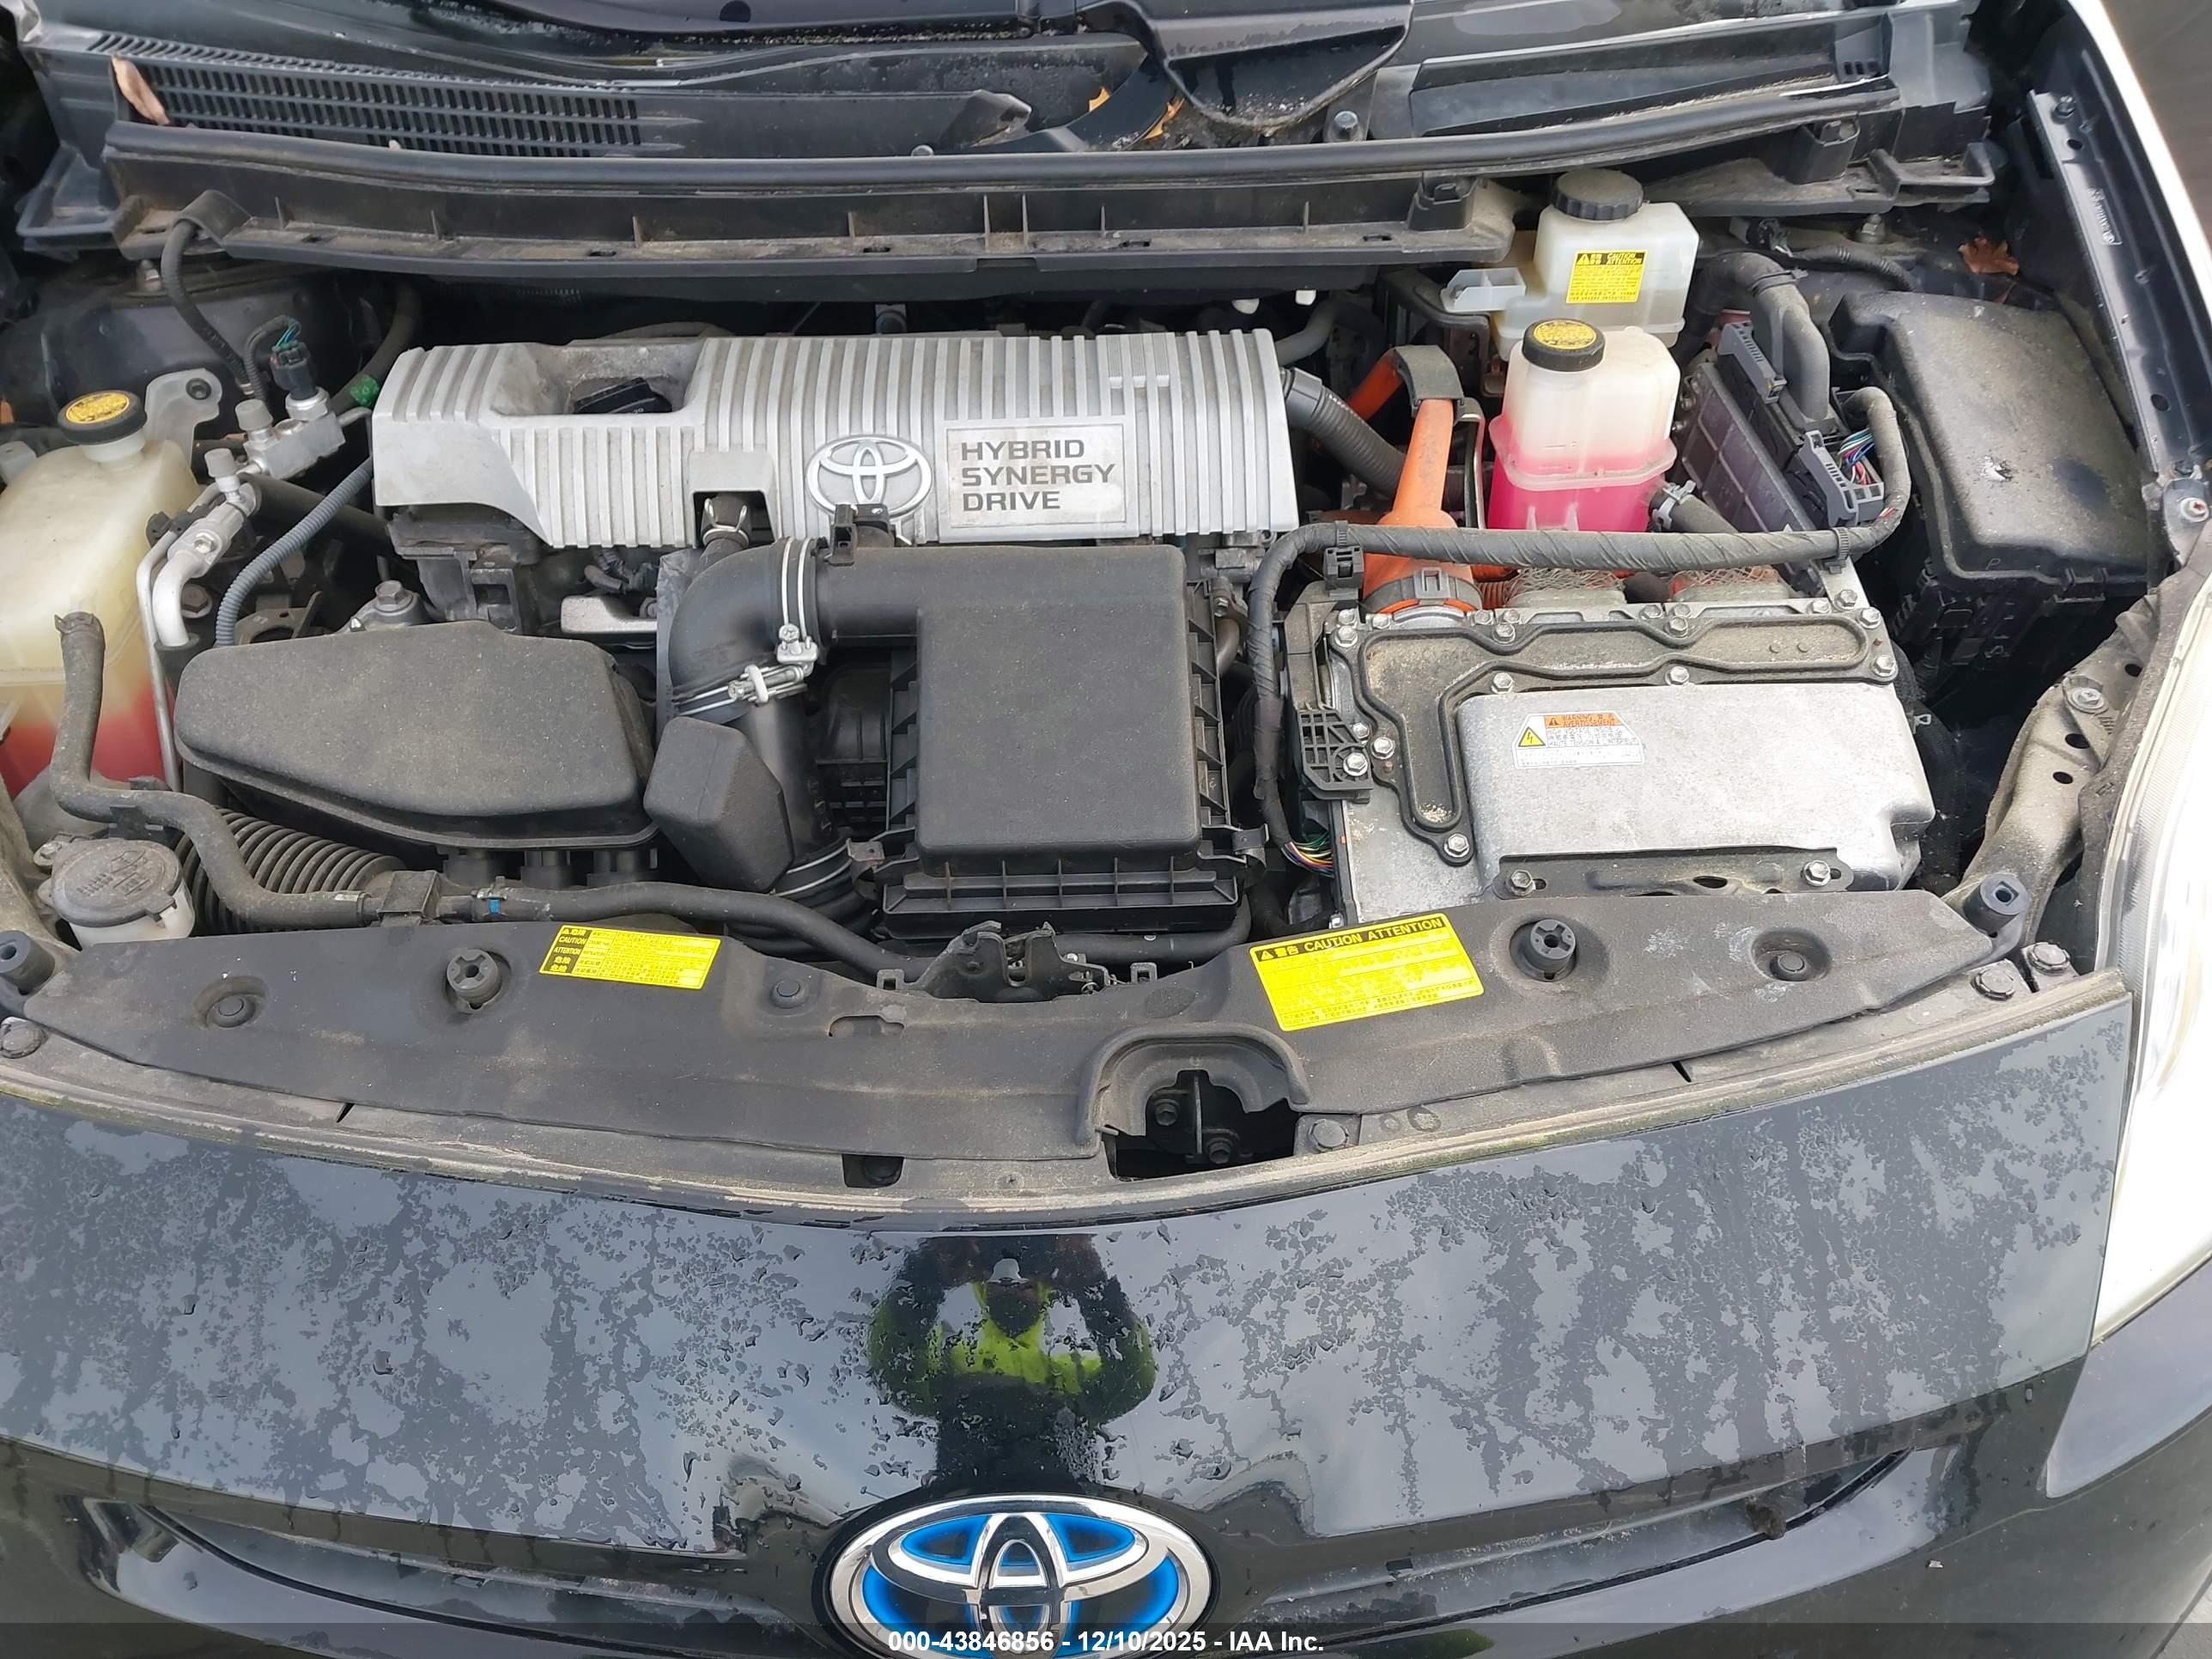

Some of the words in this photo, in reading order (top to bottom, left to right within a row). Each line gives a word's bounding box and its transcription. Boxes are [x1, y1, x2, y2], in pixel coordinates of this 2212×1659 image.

[961, 439, 1085, 461] HYBRID
[962, 464, 1115, 487] SYNERGY
[963, 490, 1061, 512] DRIVE
[558, 936, 587, 945] CAUTION
[1304, 932, 1363, 952] CAUTION
[1367, 918, 1443, 941] ATTENTION
[553, 946, 582, 956] ATTENTION
